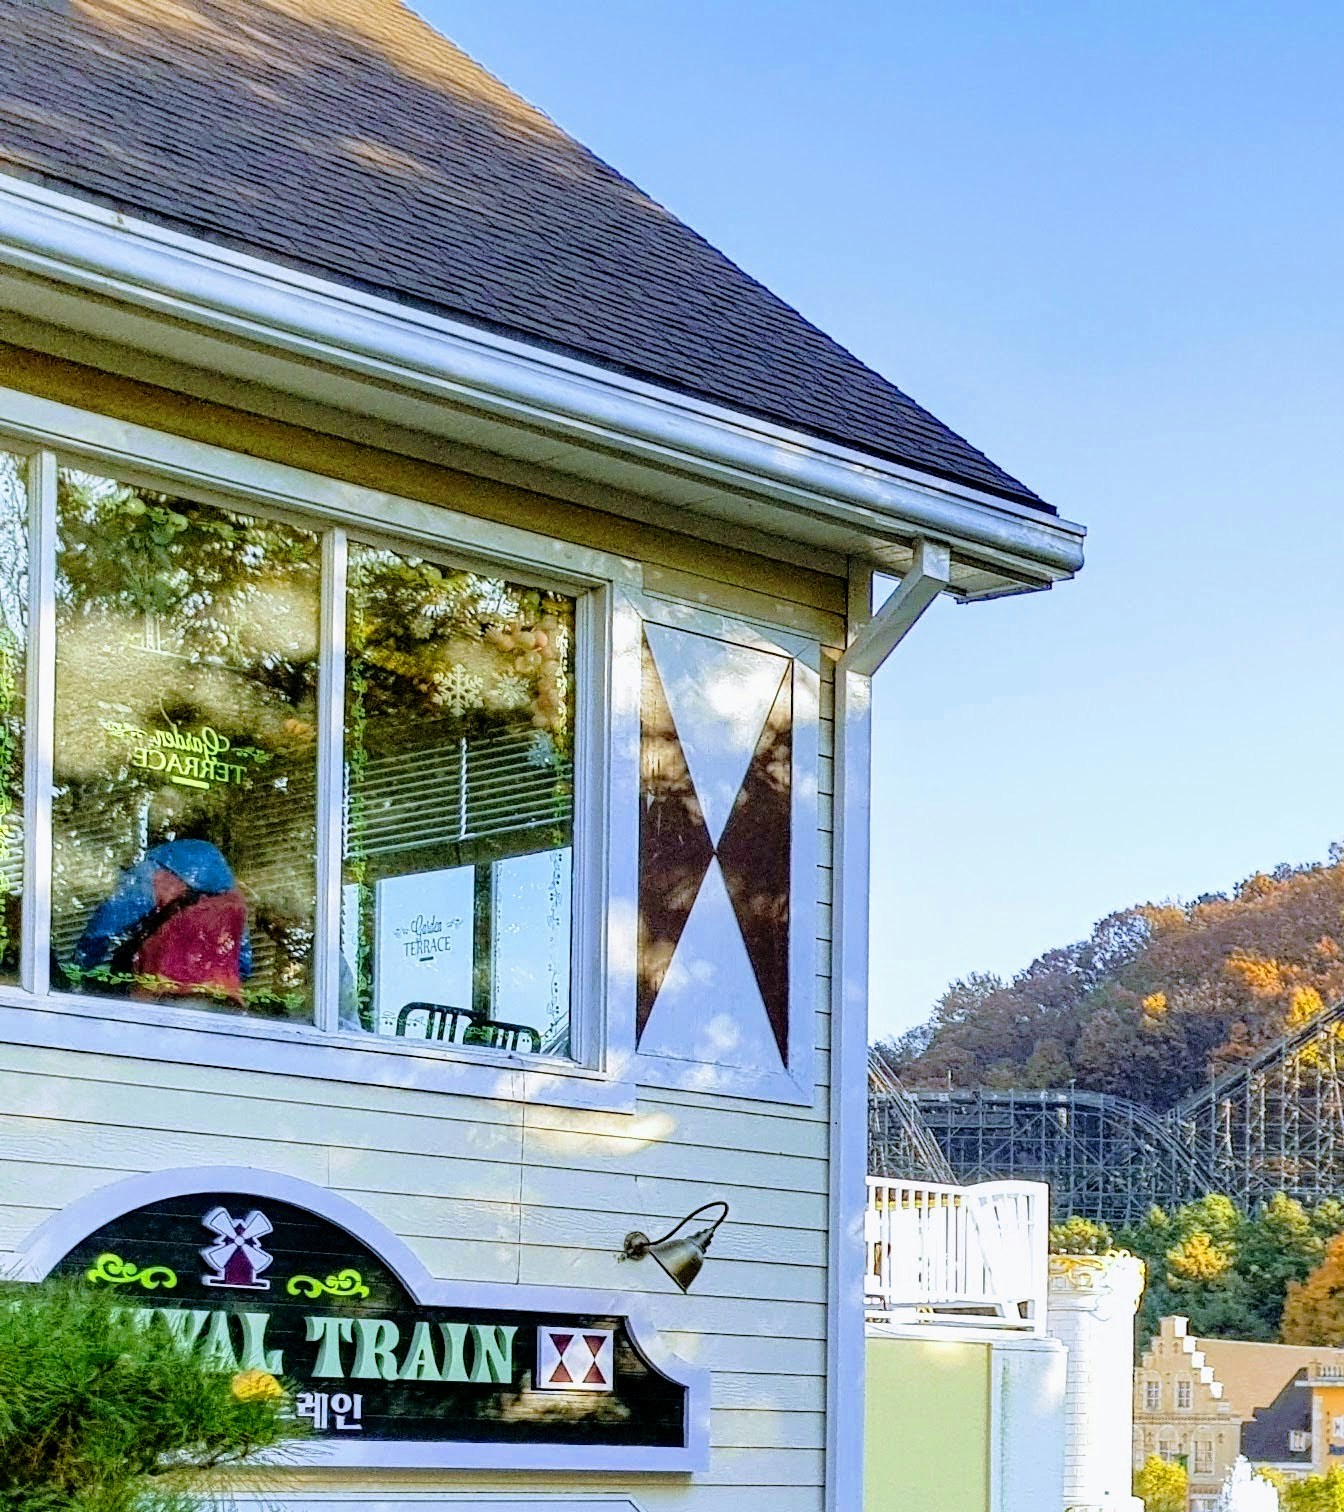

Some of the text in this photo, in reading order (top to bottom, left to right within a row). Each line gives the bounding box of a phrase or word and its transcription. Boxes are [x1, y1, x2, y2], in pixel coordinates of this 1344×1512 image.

[403, 936, 451, 956] TERRACE
[304, 1316, 519, 1384] TRAIN
[274, 1391, 364, 1431] 레인
